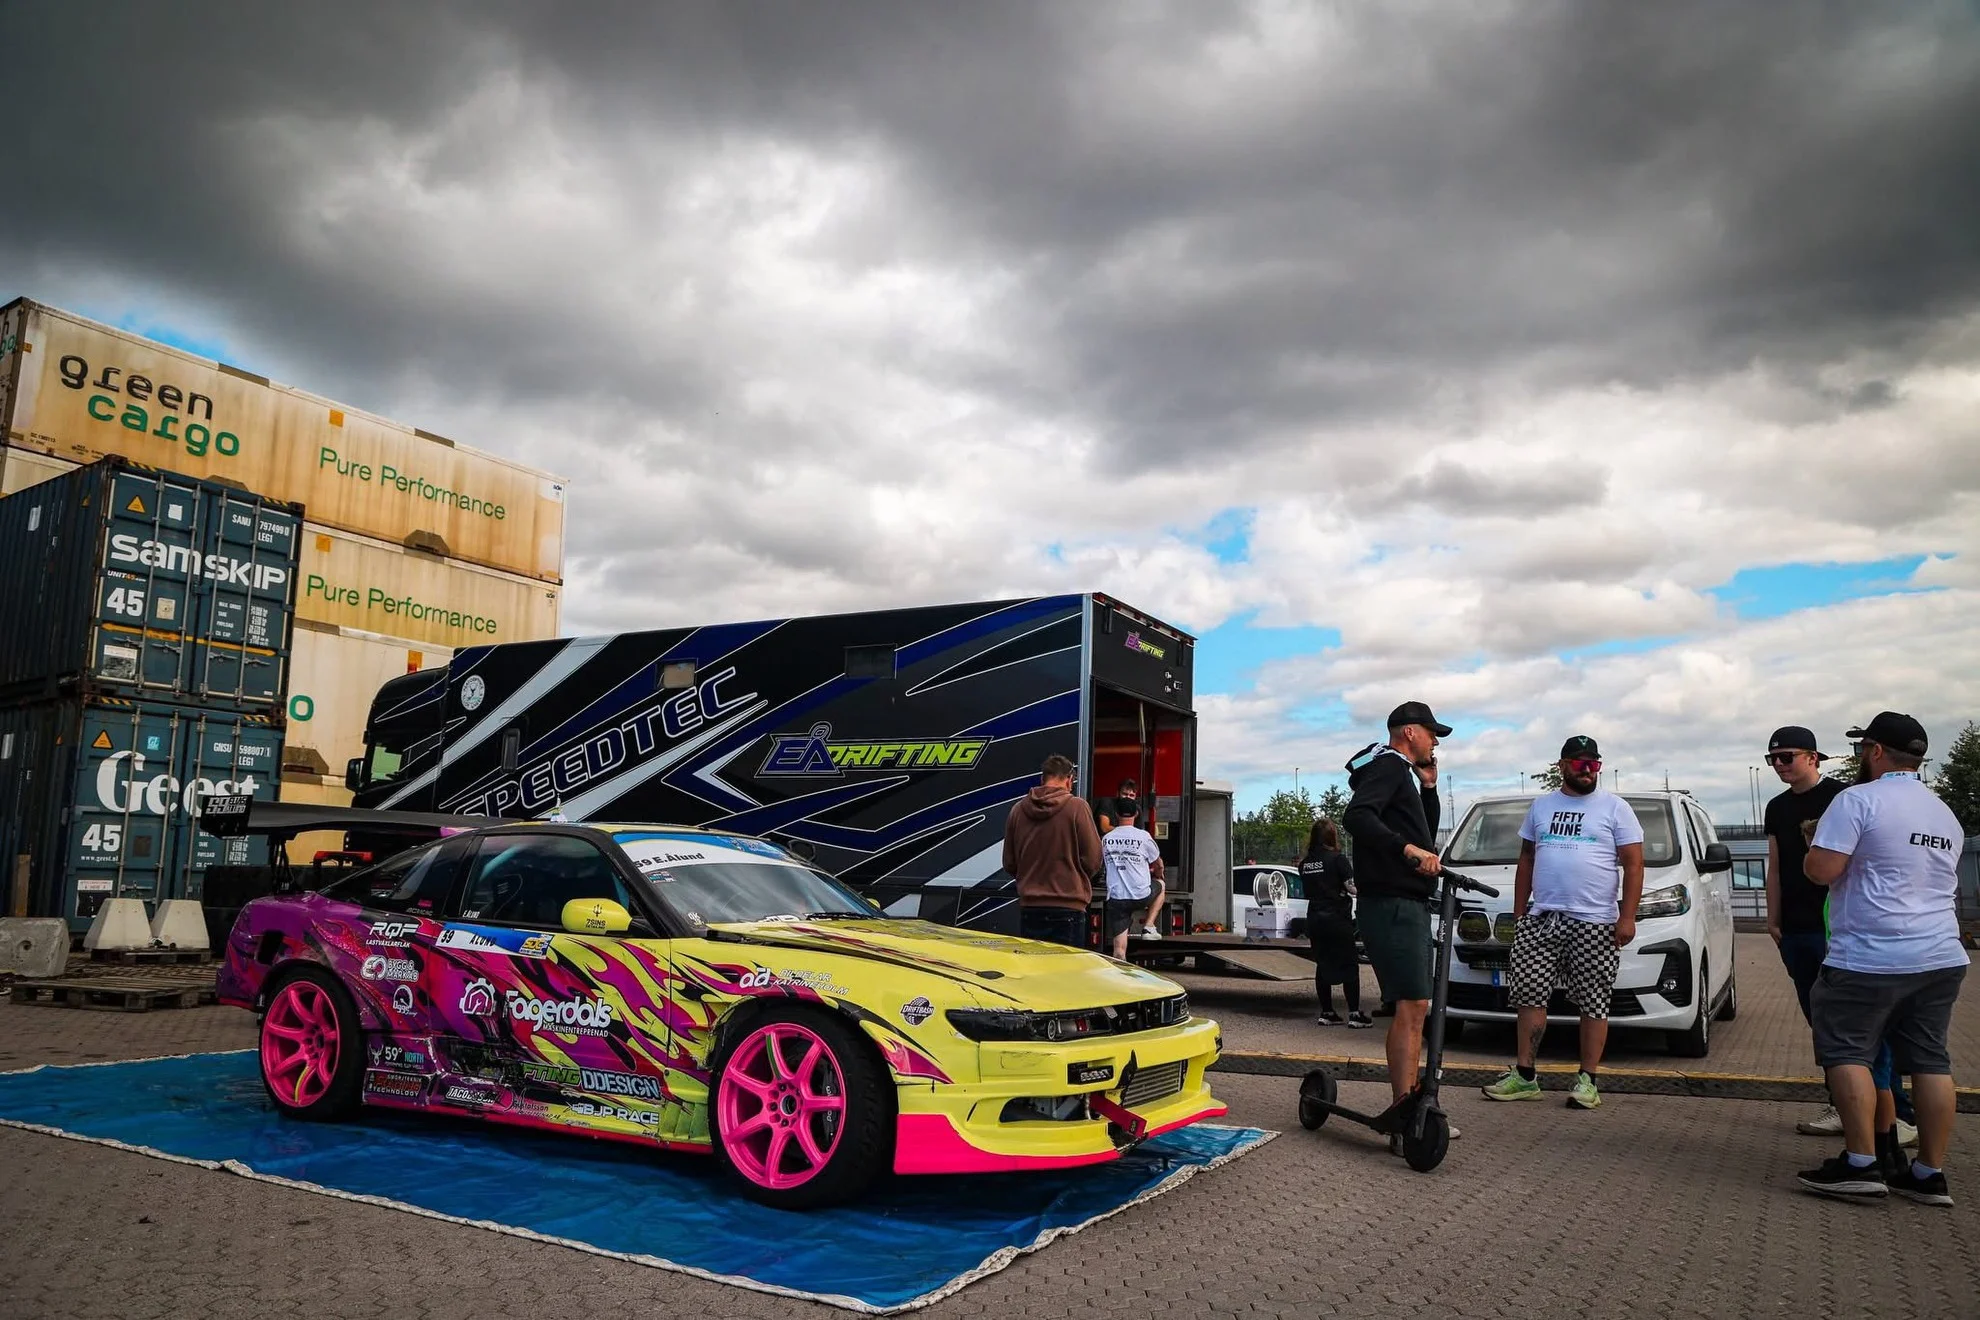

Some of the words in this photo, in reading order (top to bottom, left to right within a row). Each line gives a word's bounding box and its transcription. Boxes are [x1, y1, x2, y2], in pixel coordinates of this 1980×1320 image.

[60, 354, 213, 420] green
[88, 395, 240, 457] cargo
[320, 447, 372, 482] Pure
[380, 466, 506, 521] Performance
[106, 587, 145, 617] 45
[306, 574, 359, 608] Pure
[368, 589, 497, 634] Performance
[453, 666, 758, 818] SPEEDTEC
[96, 750, 260, 817] Geest
[1549, 822, 1583, 836] NINE
[1552, 811, 1586, 823] FIFTY
[81, 823, 122, 852] 45
[1909, 832, 1953, 851] CREW
[633, 858, 653, 869] 59
[655, 852, 706, 866] E.Ålund
[1303, 861, 1324, 870] PRESS
[440, 929, 455, 944] 59
[503, 989, 613, 1032] Fagerdals
[404, 1051, 425, 1064] NORTH
[373, 1086, 420, 1098] TECHNOLOGY
[616, 1108, 660, 1125] RACE
